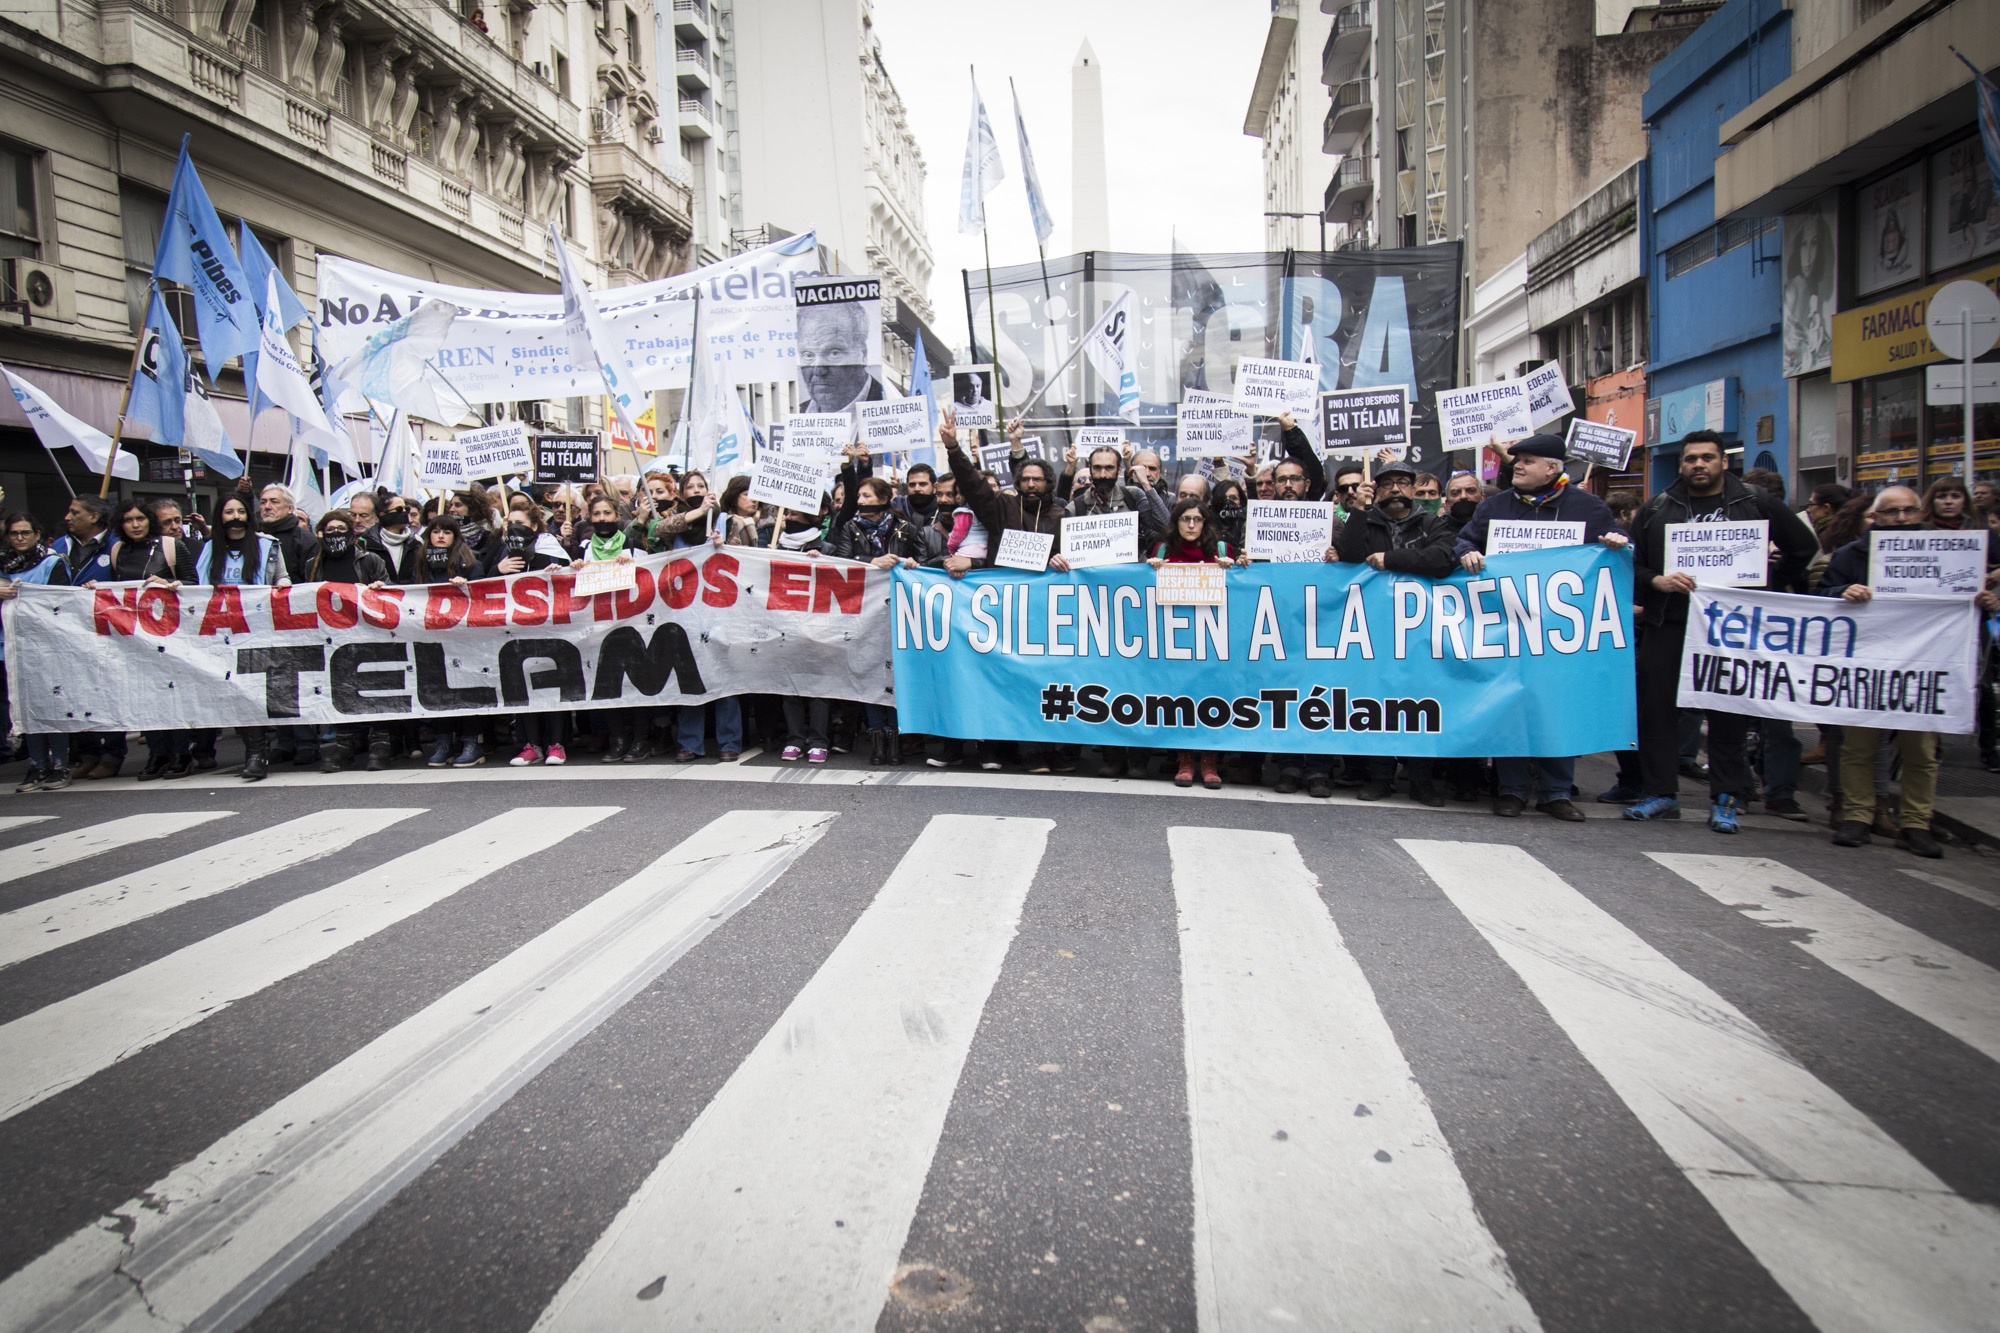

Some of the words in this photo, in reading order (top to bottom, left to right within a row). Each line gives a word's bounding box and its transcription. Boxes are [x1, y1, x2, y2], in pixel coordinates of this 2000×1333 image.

[190, 239, 242, 304] Pibes
[796, 283, 880, 303] VACIADOR
[319, 297, 370, 328] No
[372, 293, 401, 322] A
[1862, 300, 1927, 342] FARMACI
[1888, 341, 1918, 362] SALUD
[1921, 338, 1928, 354] Y
[1242, 363, 1276, 376] #TÉLAM
[1278, 366, 1314, 380] FEDERAL
[1527, 369, 1558, 391] EDERAL
[1245, 385, 1273, 398] SANTA
[1443, 392, 1480, 409] #TÉLAM
[1482, 385, 1523, 402] FEDERAL
[892, 402, 923, 414] FEDERAL
[1328, 399, 1343, 409] #NO
[1344, 399, 1350, 408] A
[1351, 397, 1364, 407] LOS
[1365, 394, 1400, 406] DESPIDOS
[1182, 408, 1212, 420] #TÉLAM
[1330, 413, 1348, 431] EN
[1351, 408, 1399, 429] TÉLAM
[1451, 413, 1485, 426] SANTIAGO
[817, 418, 847, 427] FEDERAL
[1453, 428, 1466, 436] DEL
[1467, 422, 1493, 434] ESTERO
[481, 431, 501, 441] CIERRE
[502, 430, 509, 438] DE
[510, 428, 521, 436] LAS
[869, 425, 903, 437] FORMOSA
[1187, 431, 1203, 440] SAN
[568, 441, 593, 449] DESPIDOS
[792, 438, 814, 447] SANTA
[816, 438, 834, 447] CRUZ
[440, 451, 449, 459] ME
[492, 448, 526, 461] FEDERAL
[1595, 444, 1621, 456] FEDERAL
[541, 452, 555, 466] EN
[557, 450, 592, 467] TÉLAM
[773, 458, 780, 466] AL
[782, 460, 802, 472] CIERRE
[803, 466, 810, 474] DE
[812, 468, 823, 477] LAS
[784, 483, 816, 499] FEDERAL
[1252, 505, 1287, 518] #TÉLAM
[1290, 508, 1328, 519] FEDERAL
[1099, 518, 1133, 529] FEDERAL
[1030, 535, 1044, 543] LOS
[1257, 530, 1300, 542] MISIONES
[1494, 525, 1532, 538] #TÉLAM
[1535, 528, 1577, 540] FEDERAL
[1671, 529, 1712, 542] #TÉLAM
[1716, 528, 1762, 541] FEDERAL
[1002, 538, 1047, 552] DESPIDOS
[1071, 541, 1080, 552] LA
[1083, 539, 1111, 550] PAMPA
[1878, 536, 1925, 551] #TÉLAM
[1928, 539, 1982, 551] FEDERAL
[1276, 554, 1291, 562] NO
[1303, 549, 1320, 558] LOS
[1677, 553, 1694, 567] RÍO
[1698, 554, 1733, 567] NEGRO
[1185, 567, 1199, 576] Del
[1201, 567, 1222, 576] Plata
[1884, 562, 1941, 578] NEUQUÉN
[1159, 576, 1200, 588] DESPIDE
[1209, 577, 1223, 588] NO
[93, 587, 181, 636] NO
[198, 585, 251, 636] A
[270, 581, 408, 631] LOS
[766, 559, 866, 615] EN
[1159, 589, 1222, 601] INDEMNIZA
[895, 580, 952, 652] NO
[967, 582, 1230, 661] SILENCIEN
[1248, 585, 1287, 661] A
[1304, 583, 1376, 660] LA
[1394, 566, 1627, 662] PRENSA
[1704, 600, 1858, 658] télam
[236, 621, 708, 719] TELAM
[1040, 683, 1442, 734] #SomosTélam
